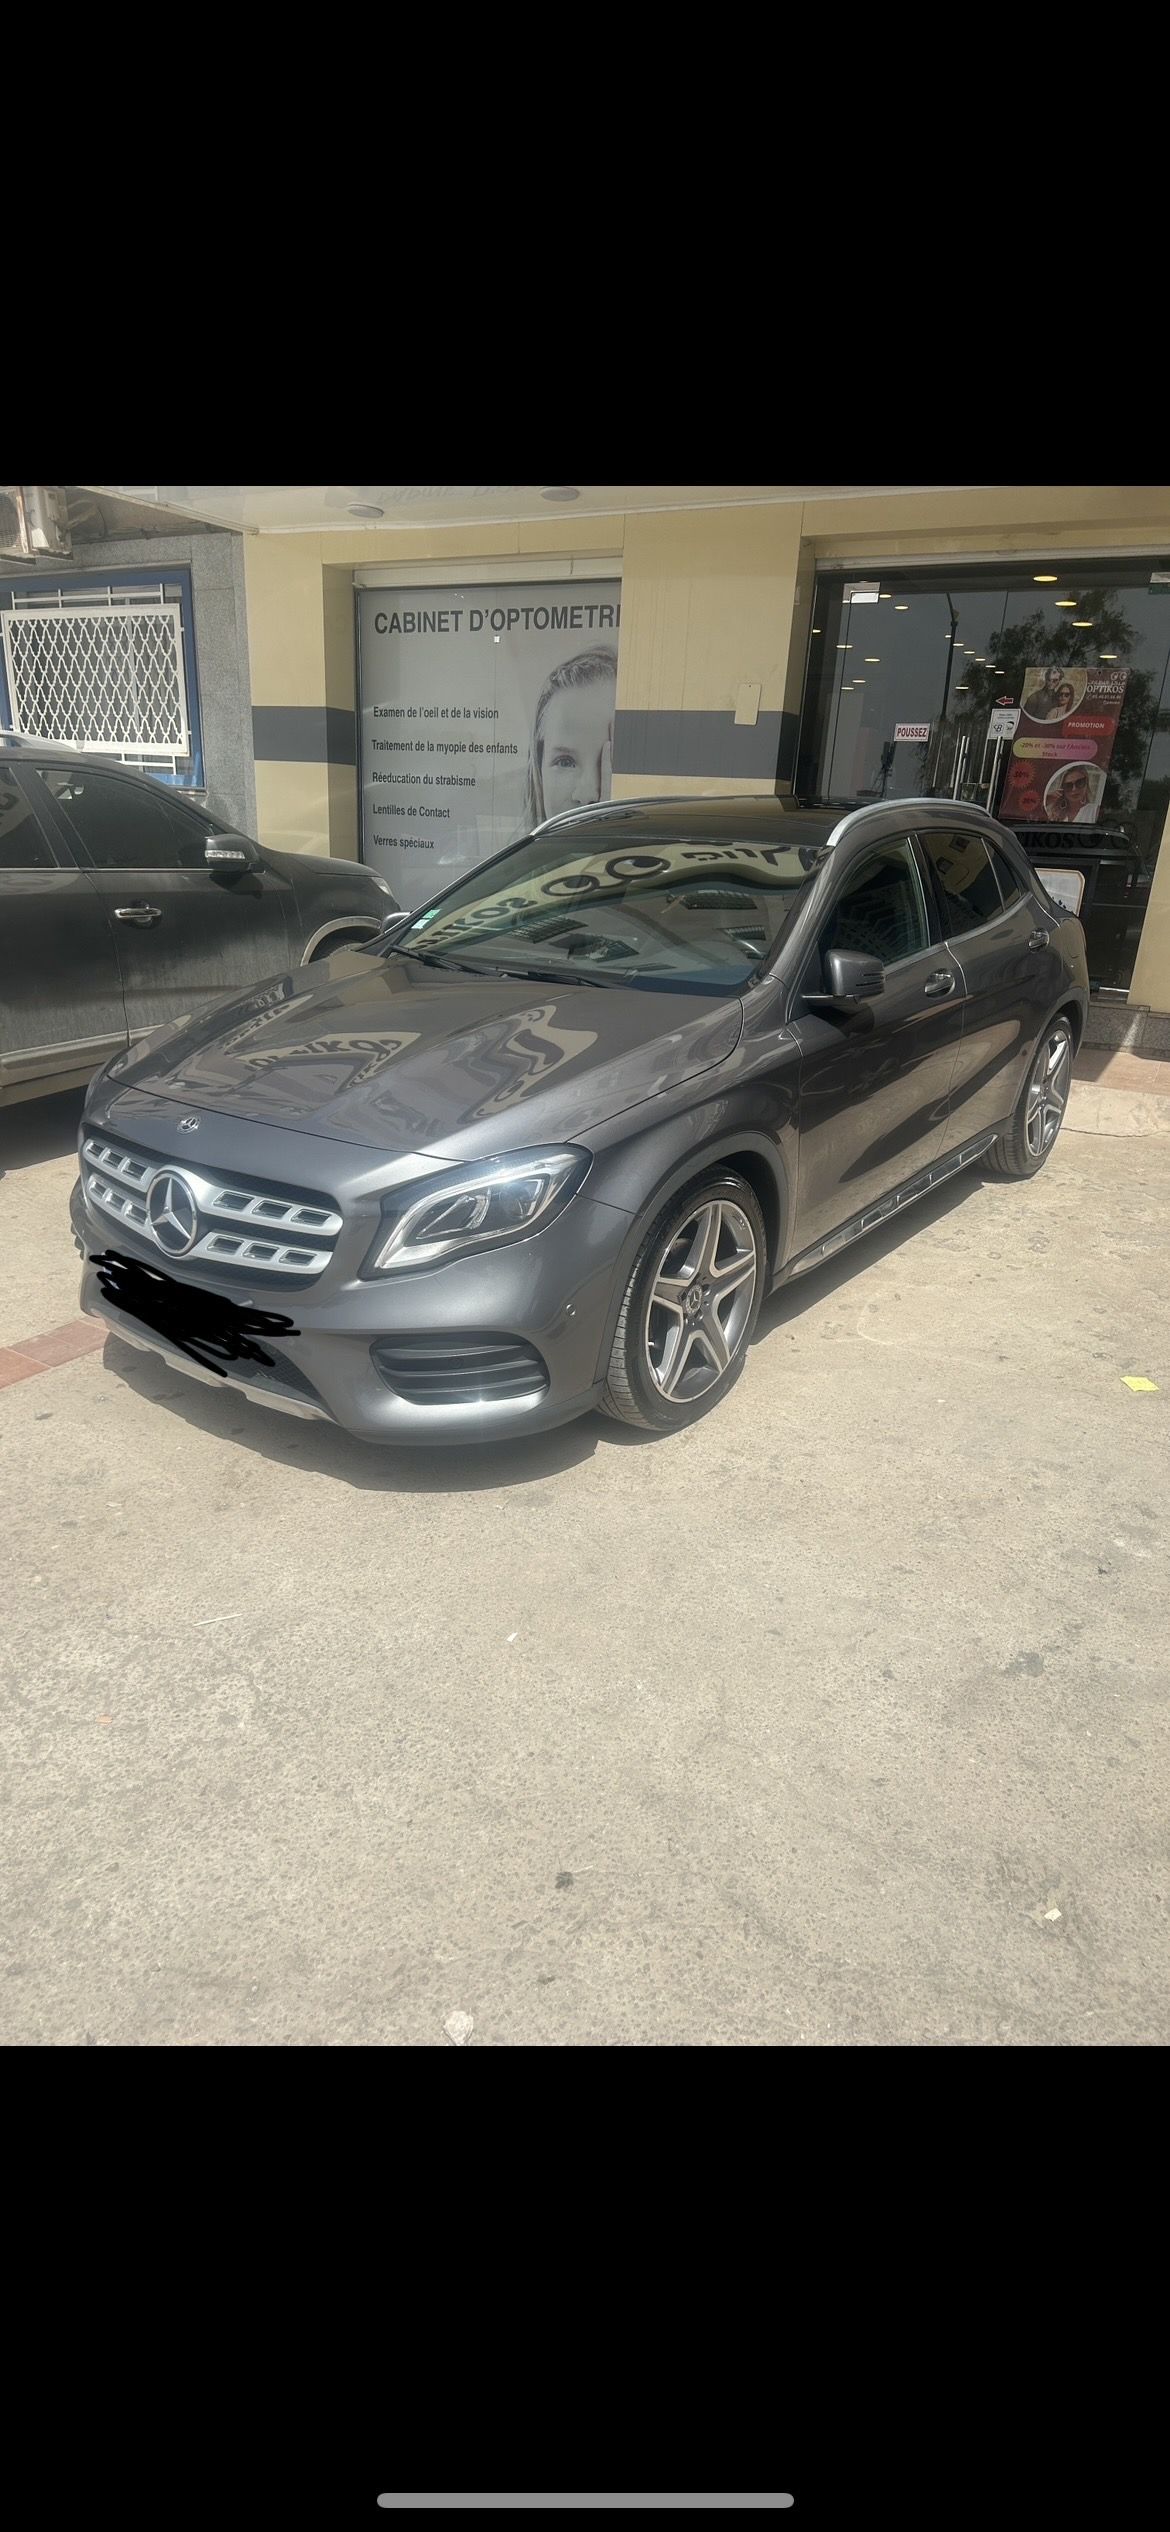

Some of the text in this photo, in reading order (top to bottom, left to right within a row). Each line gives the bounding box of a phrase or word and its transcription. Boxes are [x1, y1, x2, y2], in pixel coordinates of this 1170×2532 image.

[374, 610, 464, 634] CABINET
[373, 706, 499, 719] Examen de l'oeil et de la vision
[896, 727, 928, 737] POUSSEZ
[371, 739, 518, 755] Traitement de la myopie des enfants
[423, 774, 433, 785] du
[435, 774, 476, 786] strabisme
[372, 803, 450, 818] Lentilles de Contact
[373, 834, 435, 849] Verres spéciaux
